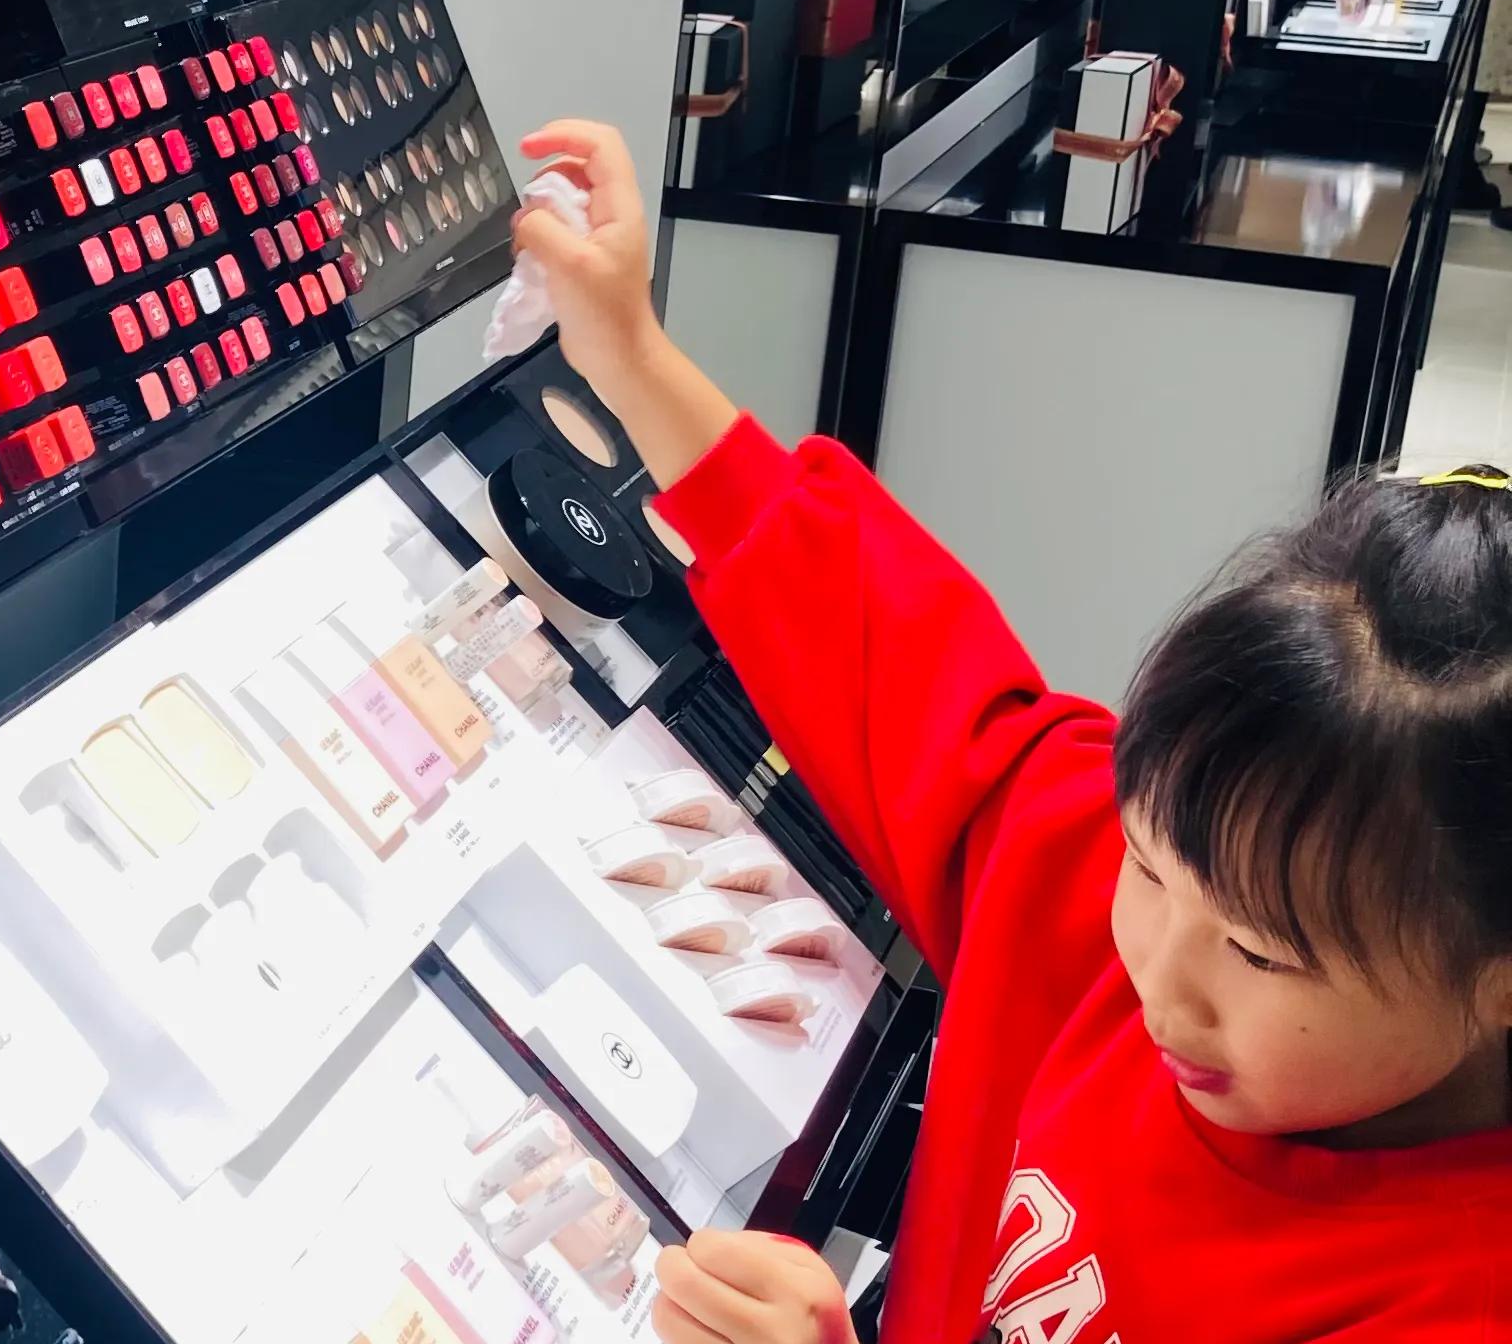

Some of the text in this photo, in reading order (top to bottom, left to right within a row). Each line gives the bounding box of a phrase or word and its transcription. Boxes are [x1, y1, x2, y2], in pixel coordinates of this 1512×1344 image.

[454, 714, 480, 738] CHANEL
[415, 752, 441, 777] CHANEL
[372, 790, 400, 818] CHANEL
